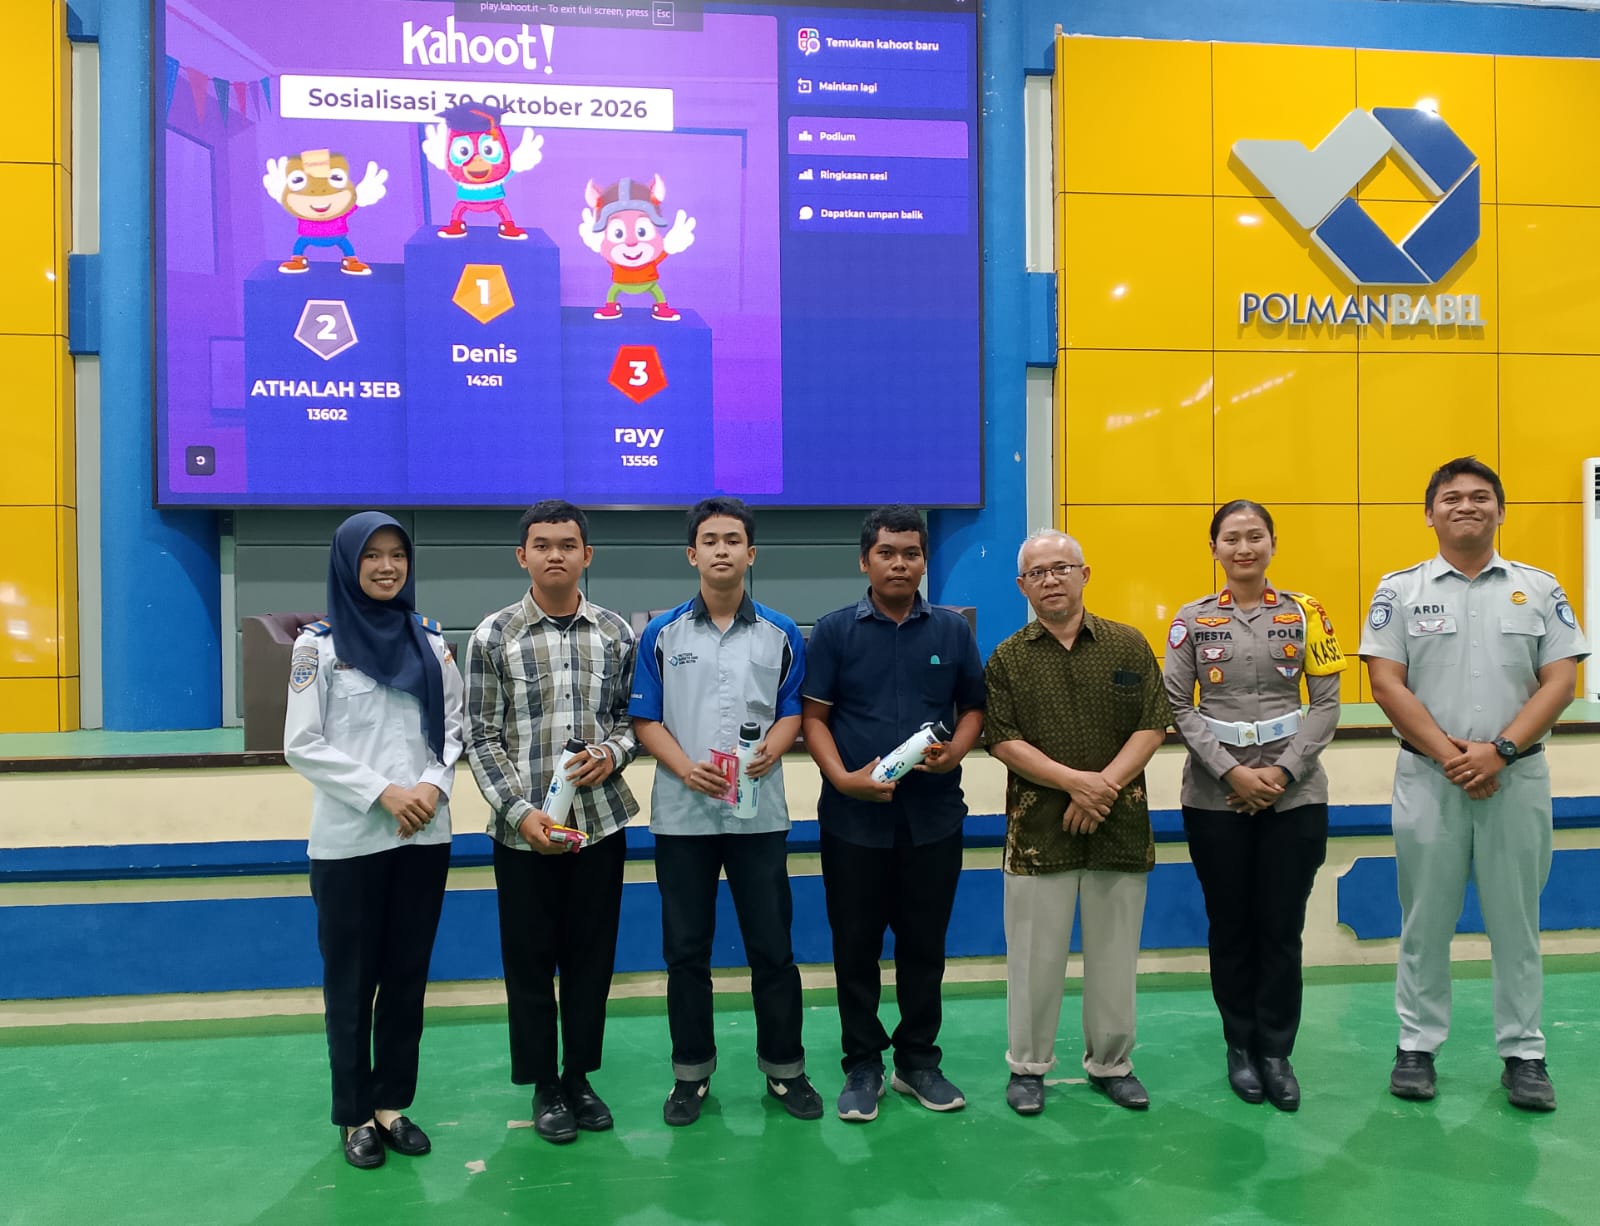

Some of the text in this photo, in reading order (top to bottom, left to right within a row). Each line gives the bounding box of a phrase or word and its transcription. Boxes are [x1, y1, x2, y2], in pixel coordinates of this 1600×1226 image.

[480, 2, 539, 14] play.kahoot.it
[549, 5, 559, 13] To
[560, 6, 577, 15] exit
[578, 6, 592, 15] full
[594, 9, 624, 17] screen,
[626, 10, 649, 18] press
[656, 9, 671, 19] Esc
[402, 15, 555, 75] Kahoot!
[826, 37, 939, 51] Temukan kahoot baru
[819, 82, 878, 93] Mainkan lagi
[308, 88, 437, 111] Sosialisasi
[590, 99, 648, 118] 2026
[820, 132, 856, 141] Podium
[820, 170, 888, 181] Ringkasan sesi
[820, 209, 923, 220] Dapatkan umpan balik
[475, 278, 490, 305] 1
[314, 314, 338, 341] 2
[451, 343, 518, 364] Denis
[466, 374, 504, 387] 14261
[628, 360, 649, 387] 3
[250, 379, 401, 398] ATHALAH 3EB
[306, 407, 348, 421] 13602
[614, 427, 665, 448] rayy
[621, 454, 658, 467] 13556
[1413, 603, 1446, 616] ARDI
[1194, 631, 1232, 642] FIESTA
